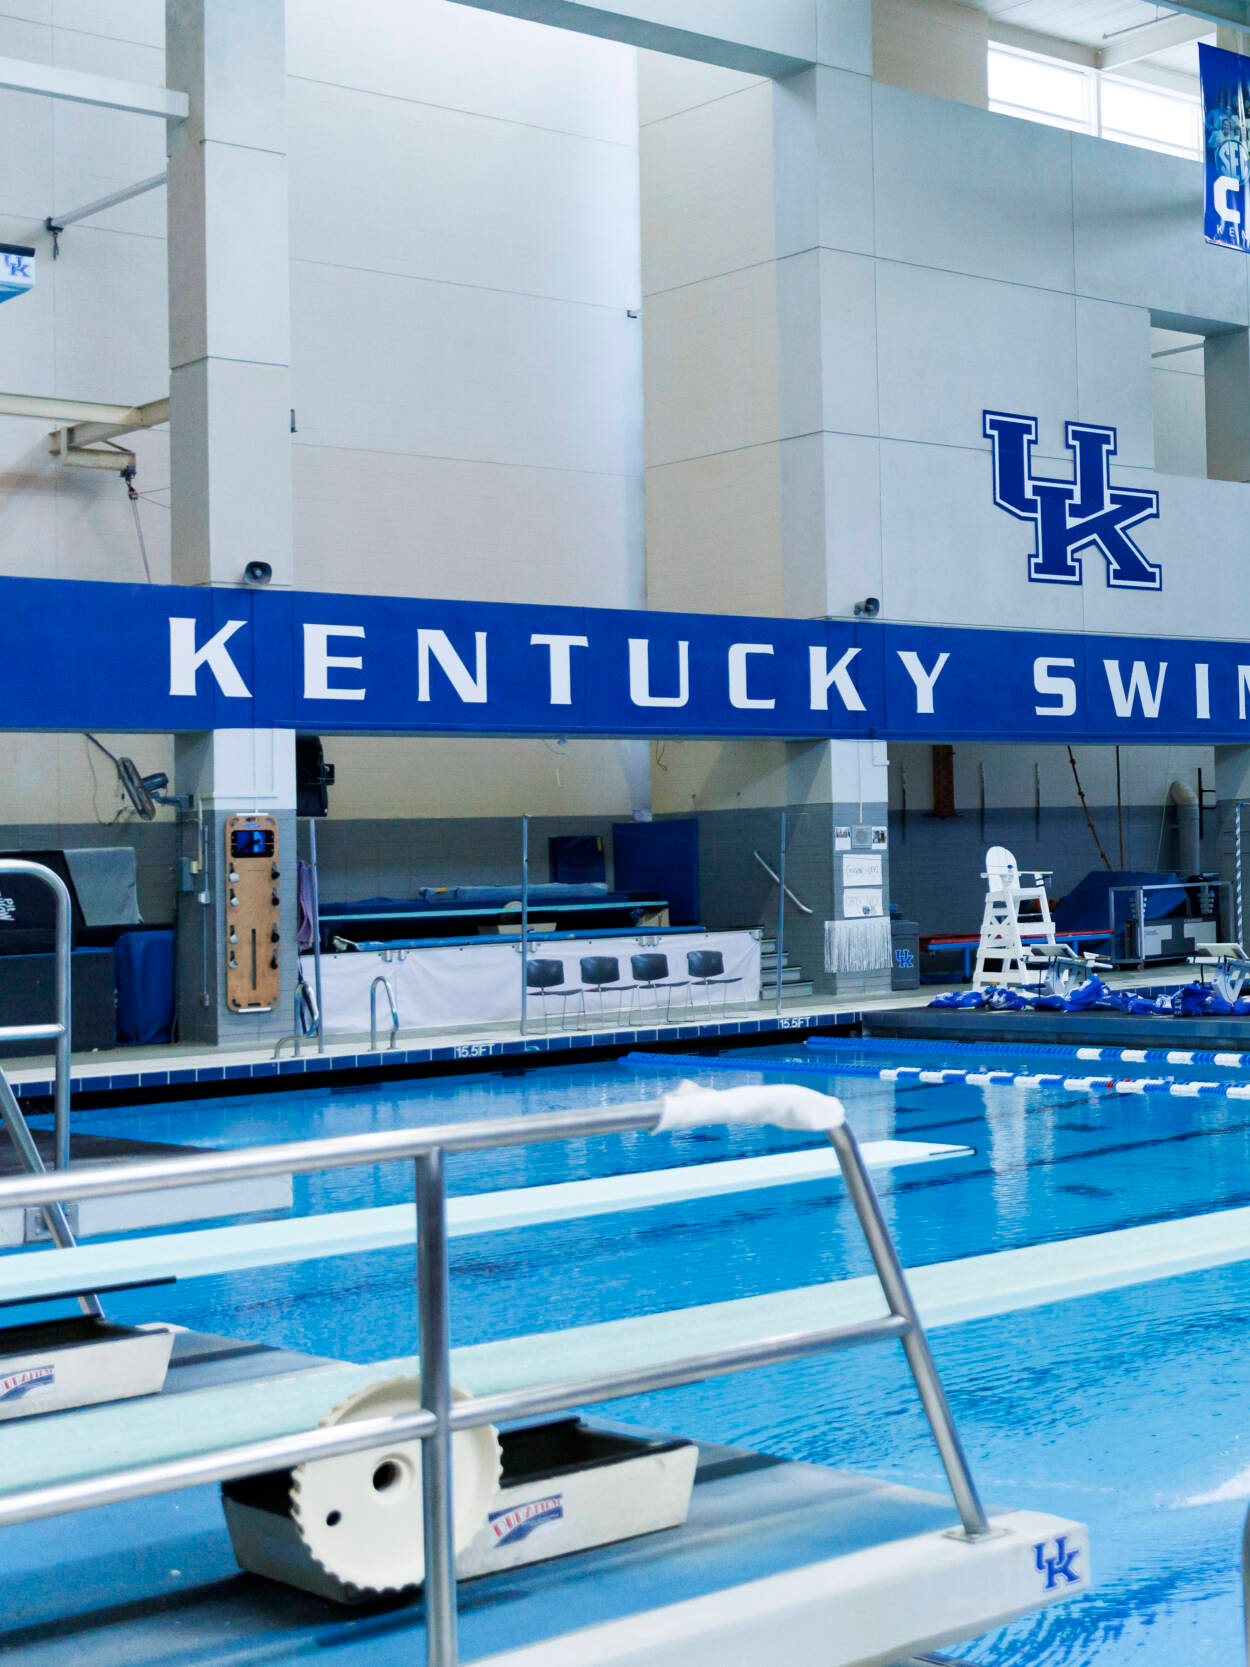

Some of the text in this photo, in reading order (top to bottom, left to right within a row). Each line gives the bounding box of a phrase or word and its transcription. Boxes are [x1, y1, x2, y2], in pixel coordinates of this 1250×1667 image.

[3, 254, 31, 278] UK
[983, 409, 1162, 592] UK
[169, 617, 951, 713] KENTUCKY
[895, 949, 913, 968] UK
[779, 1016, 811, 1029] 15.5FT
[456, 1044, 495, 1058] 15.5FT
[1032, 1535, 1081, 1589] UK
